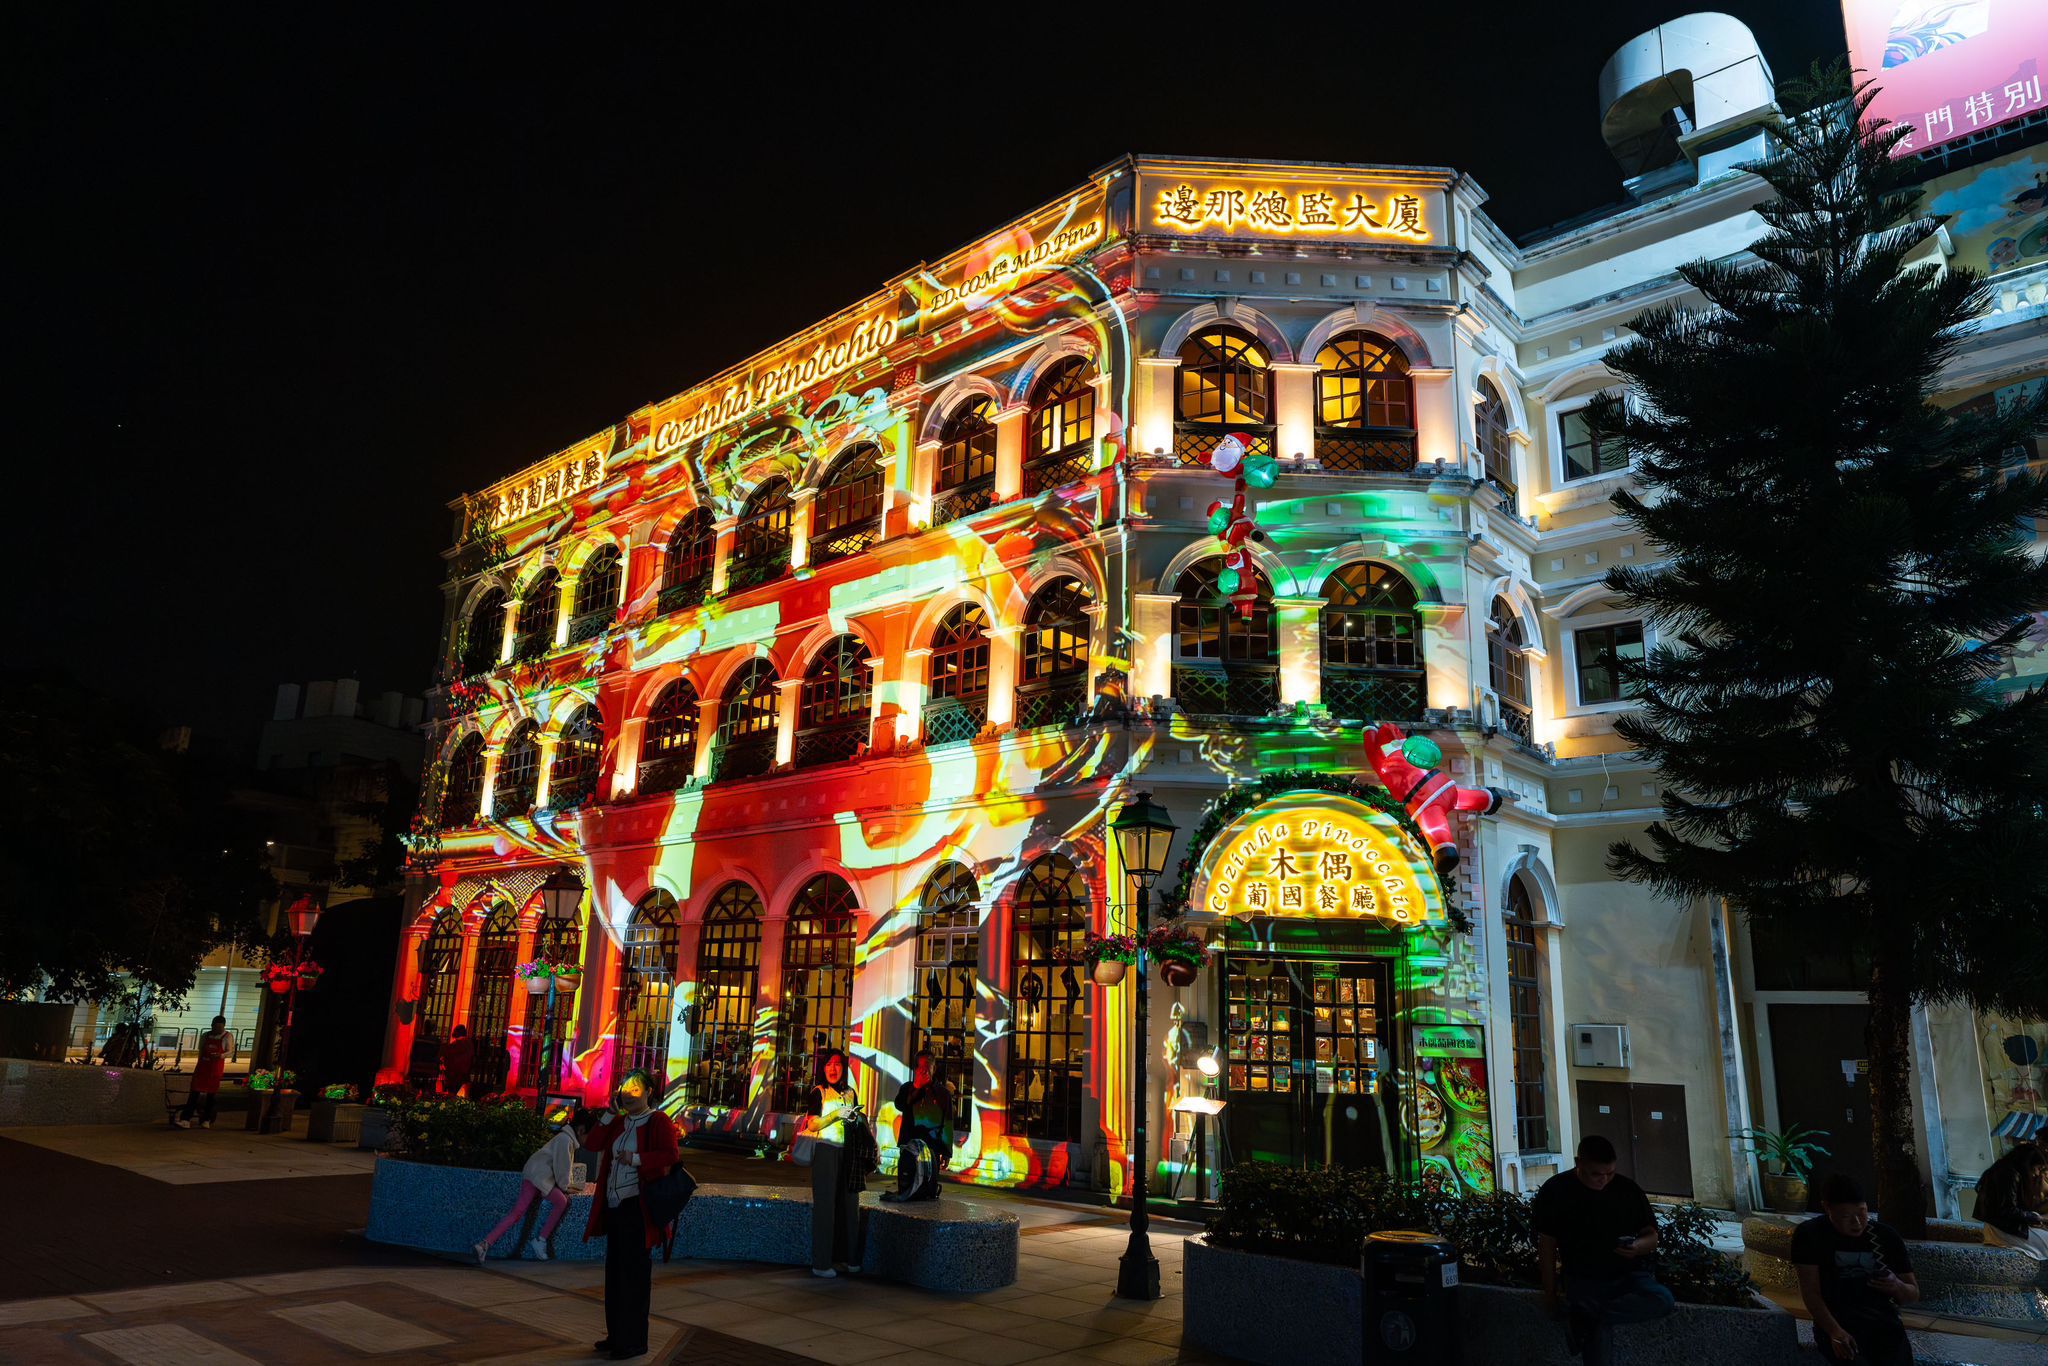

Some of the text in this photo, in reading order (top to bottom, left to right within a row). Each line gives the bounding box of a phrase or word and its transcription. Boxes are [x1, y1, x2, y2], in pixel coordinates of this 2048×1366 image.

[1159, 184, 1428, 236] 邊那總監大廈
[653, 314, 893, 453] Cozinha Pinócchio
[489, 450, 603, 526] 木偶葡國餐廳
[1211, 820, 1410, 922] Cozinha Pinócchio
[1246, 882, 1377, 910] 葡國餐廳
[1267, 847, 1353, 881] 木偶
